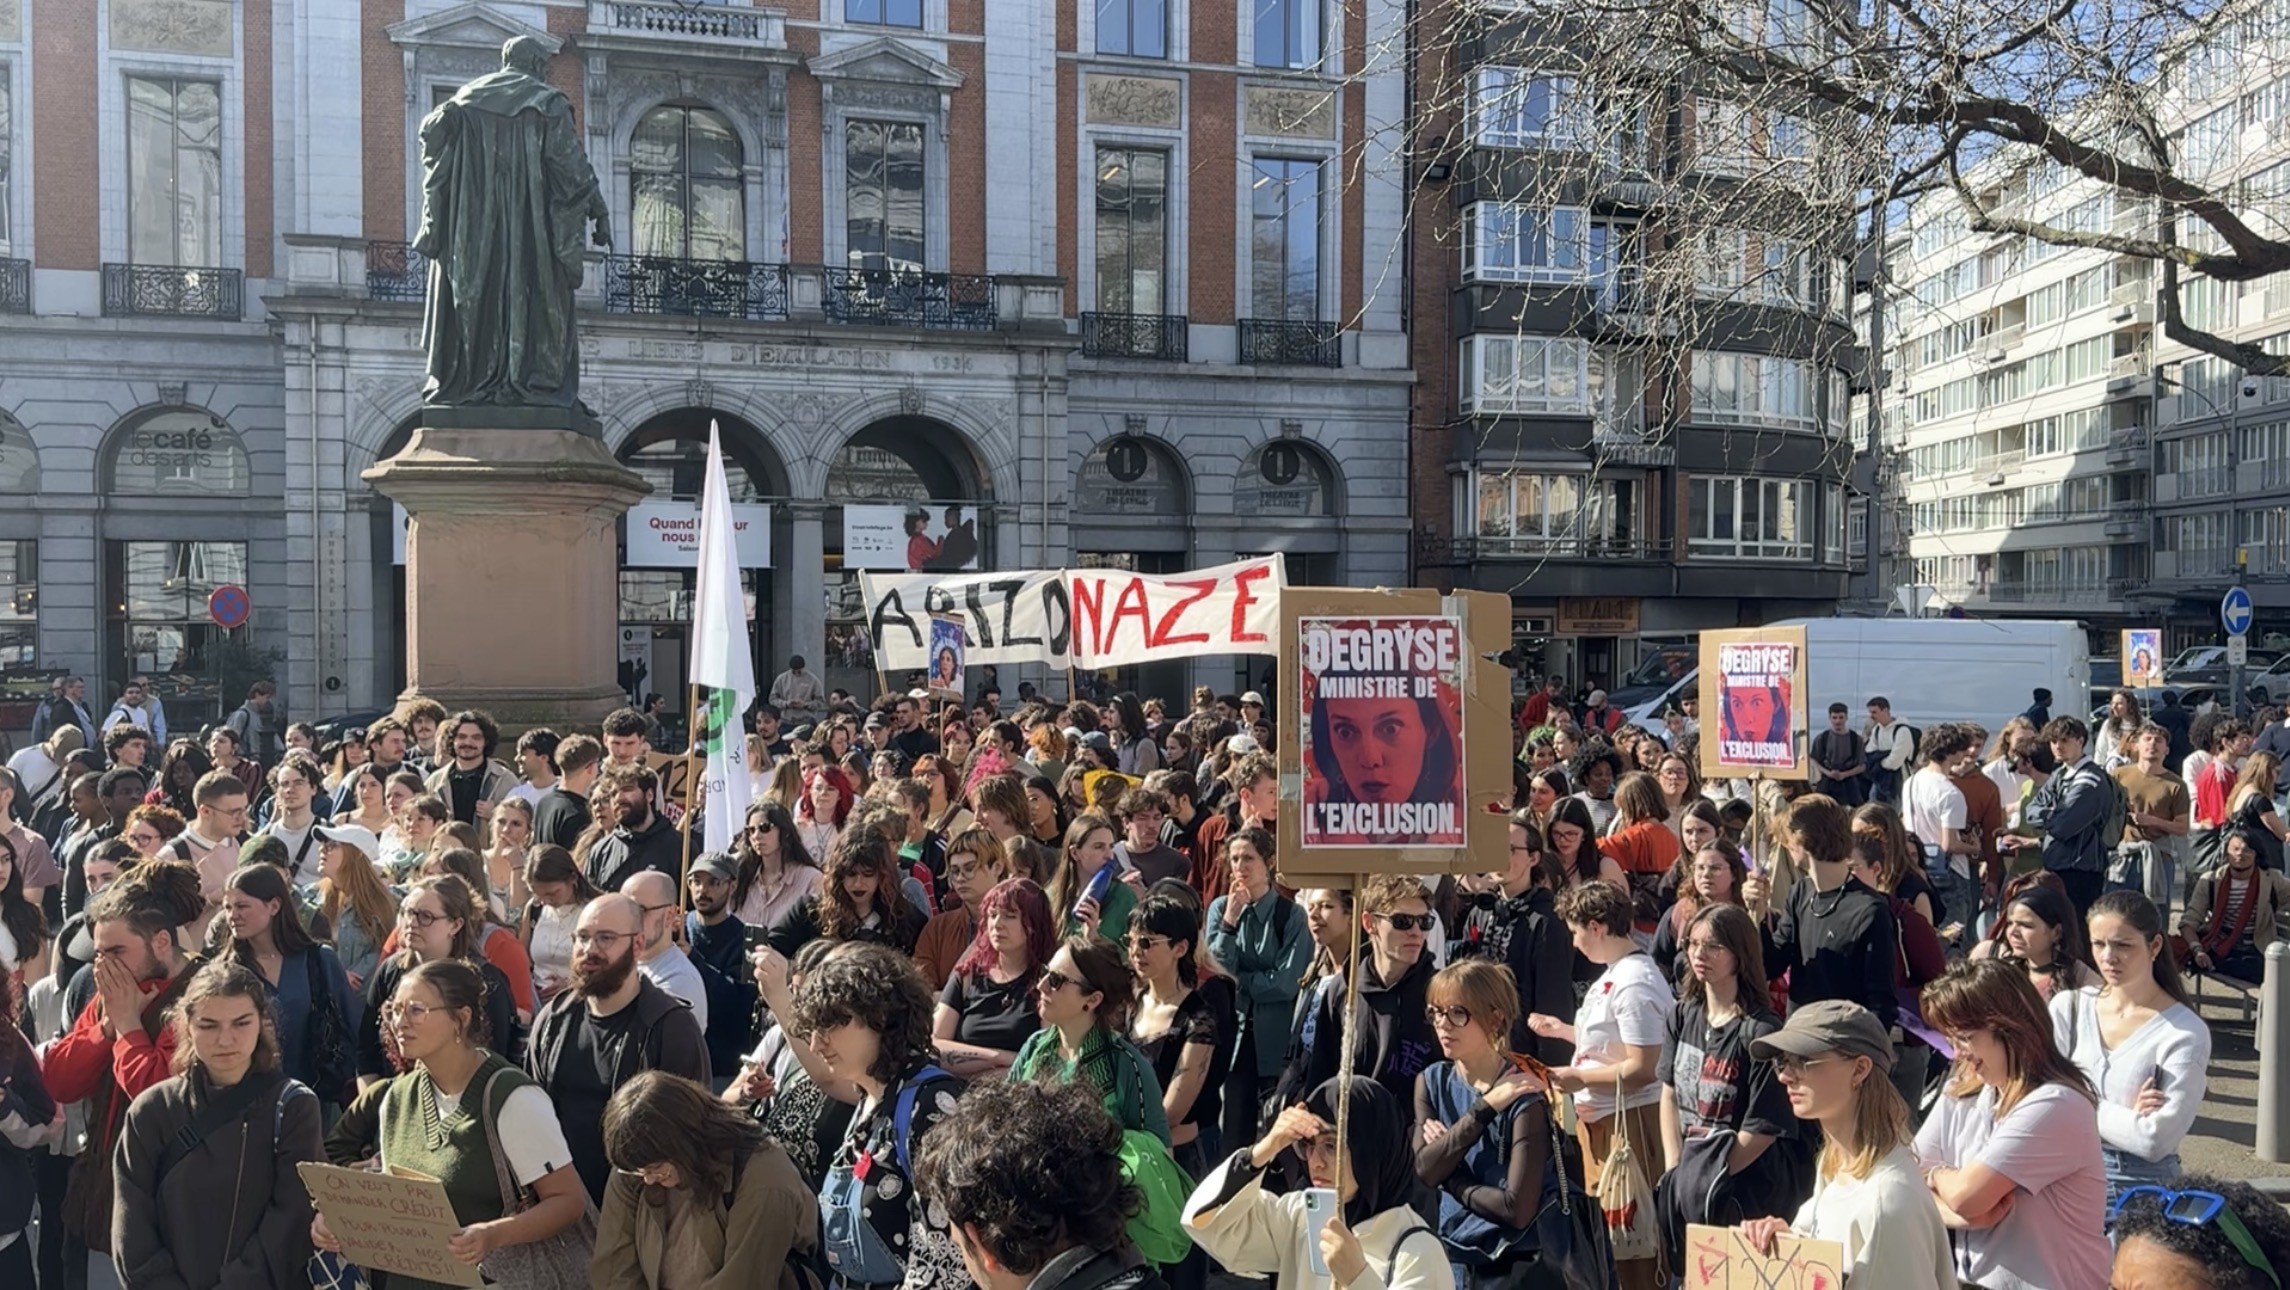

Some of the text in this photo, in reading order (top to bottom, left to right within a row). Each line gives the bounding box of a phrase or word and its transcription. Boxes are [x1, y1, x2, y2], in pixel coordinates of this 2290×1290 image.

[650, 517, 694, 530] Quand
[662, 532, 695, 542] nous
[1308, 626, 1455, 672] DEGRYSE
[1721, 650, 1790, 673] DEGRYSE
[1319, 677, 1438, 699] MINISTRE DE
[1726, 675, 1780, 688] MINISTRE DE
[1720, 740, 1792, 760] L'EXCLUSION.
[1306, 802, 1462, 835] L'EXCLUSION.
[326, 1173, 433, 1200] ON VEUT PAS
[338, 1215, 434, 1240] POUR POUVOIR
